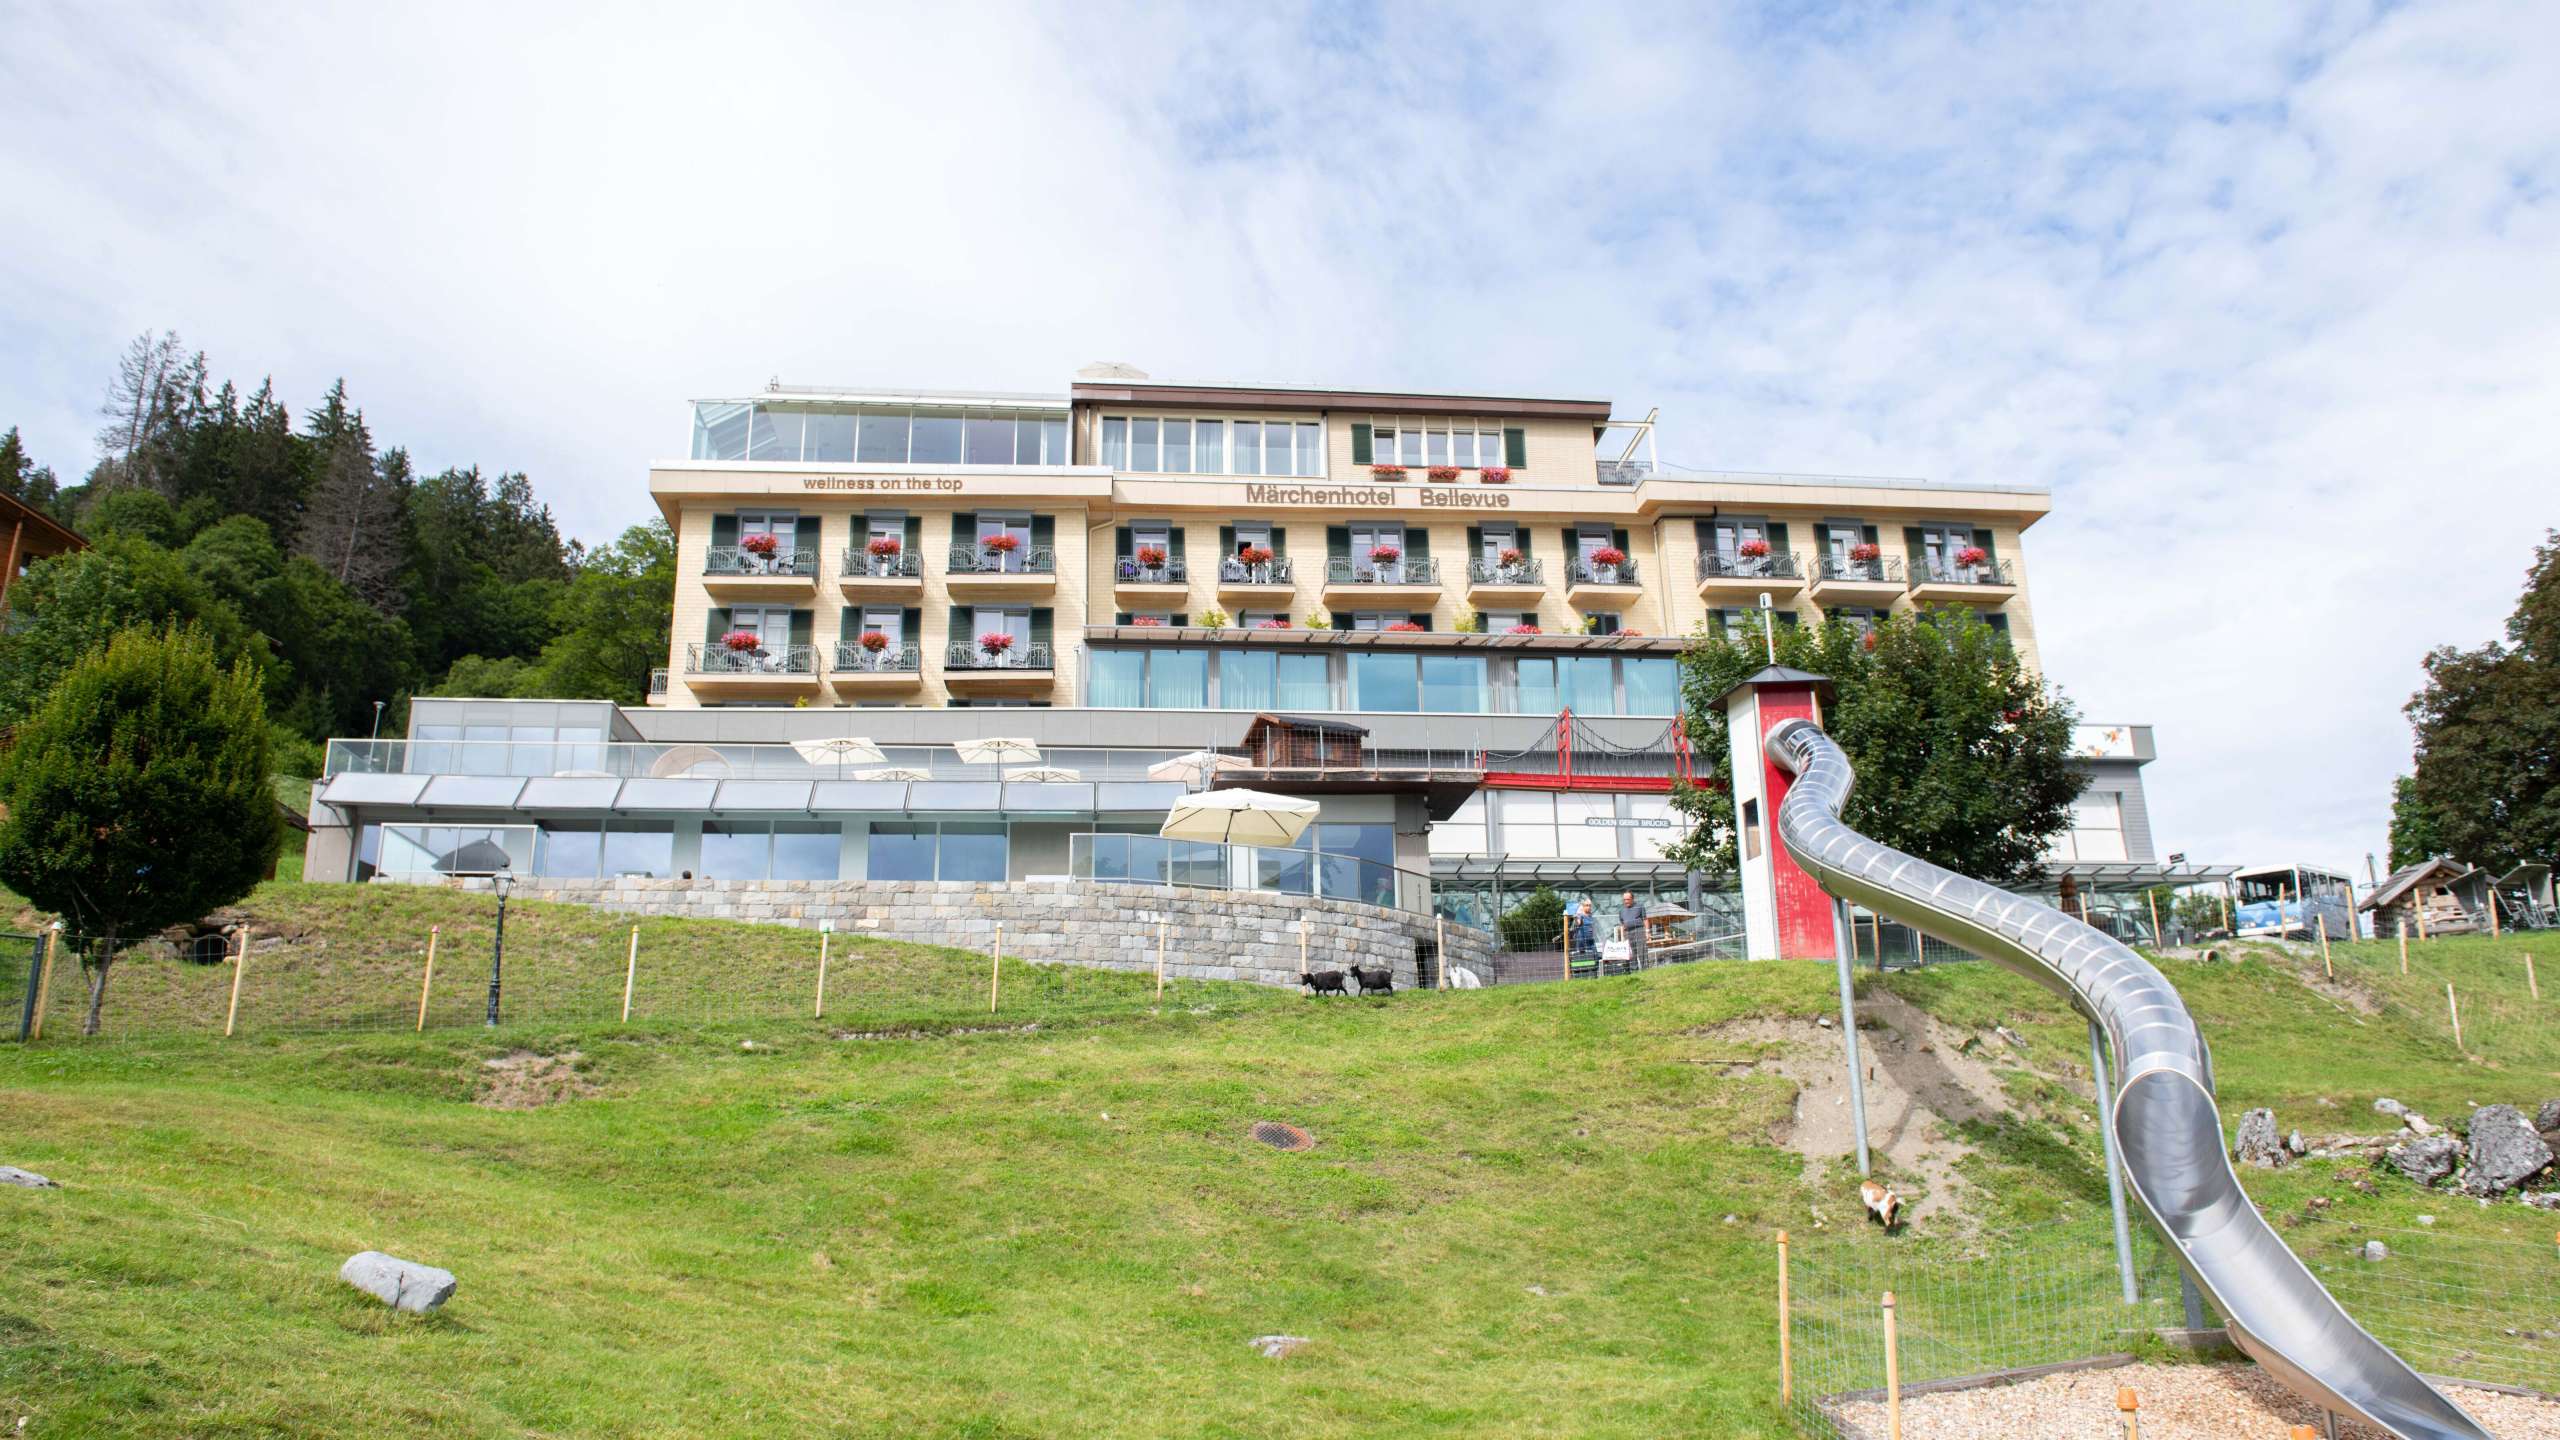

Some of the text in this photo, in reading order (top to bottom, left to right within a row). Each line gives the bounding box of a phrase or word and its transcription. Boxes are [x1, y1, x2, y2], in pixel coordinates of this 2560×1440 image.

[803, 477, 963, 492] wellness on the top
[1246, 485, 1510, 507] Märchenhotel Bellevue
[1588, 818, 1617, 826] GOLDEN
